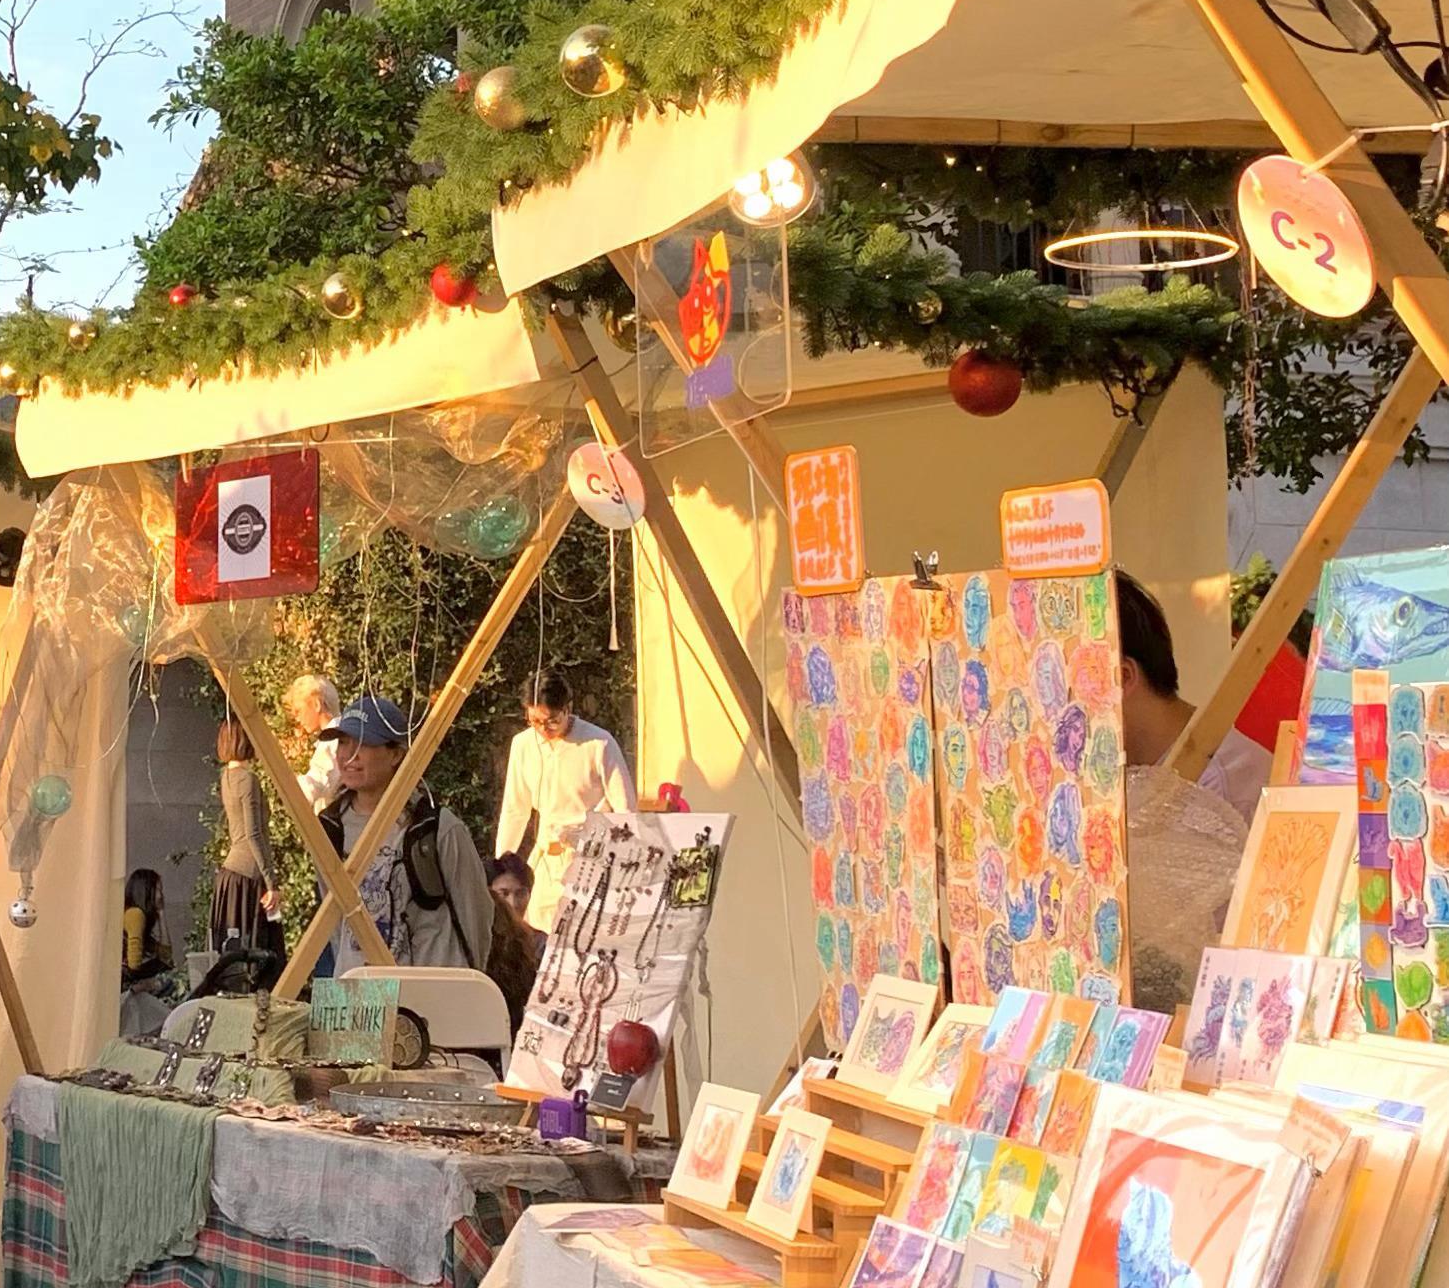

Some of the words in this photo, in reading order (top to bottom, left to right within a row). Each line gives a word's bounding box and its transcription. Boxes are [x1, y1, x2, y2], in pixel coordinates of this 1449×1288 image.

[1271, 211, 1338, 275] C-2
[586, 473, 625, 505] C-3
[311, 1006, 347, 1031] LITTLE
